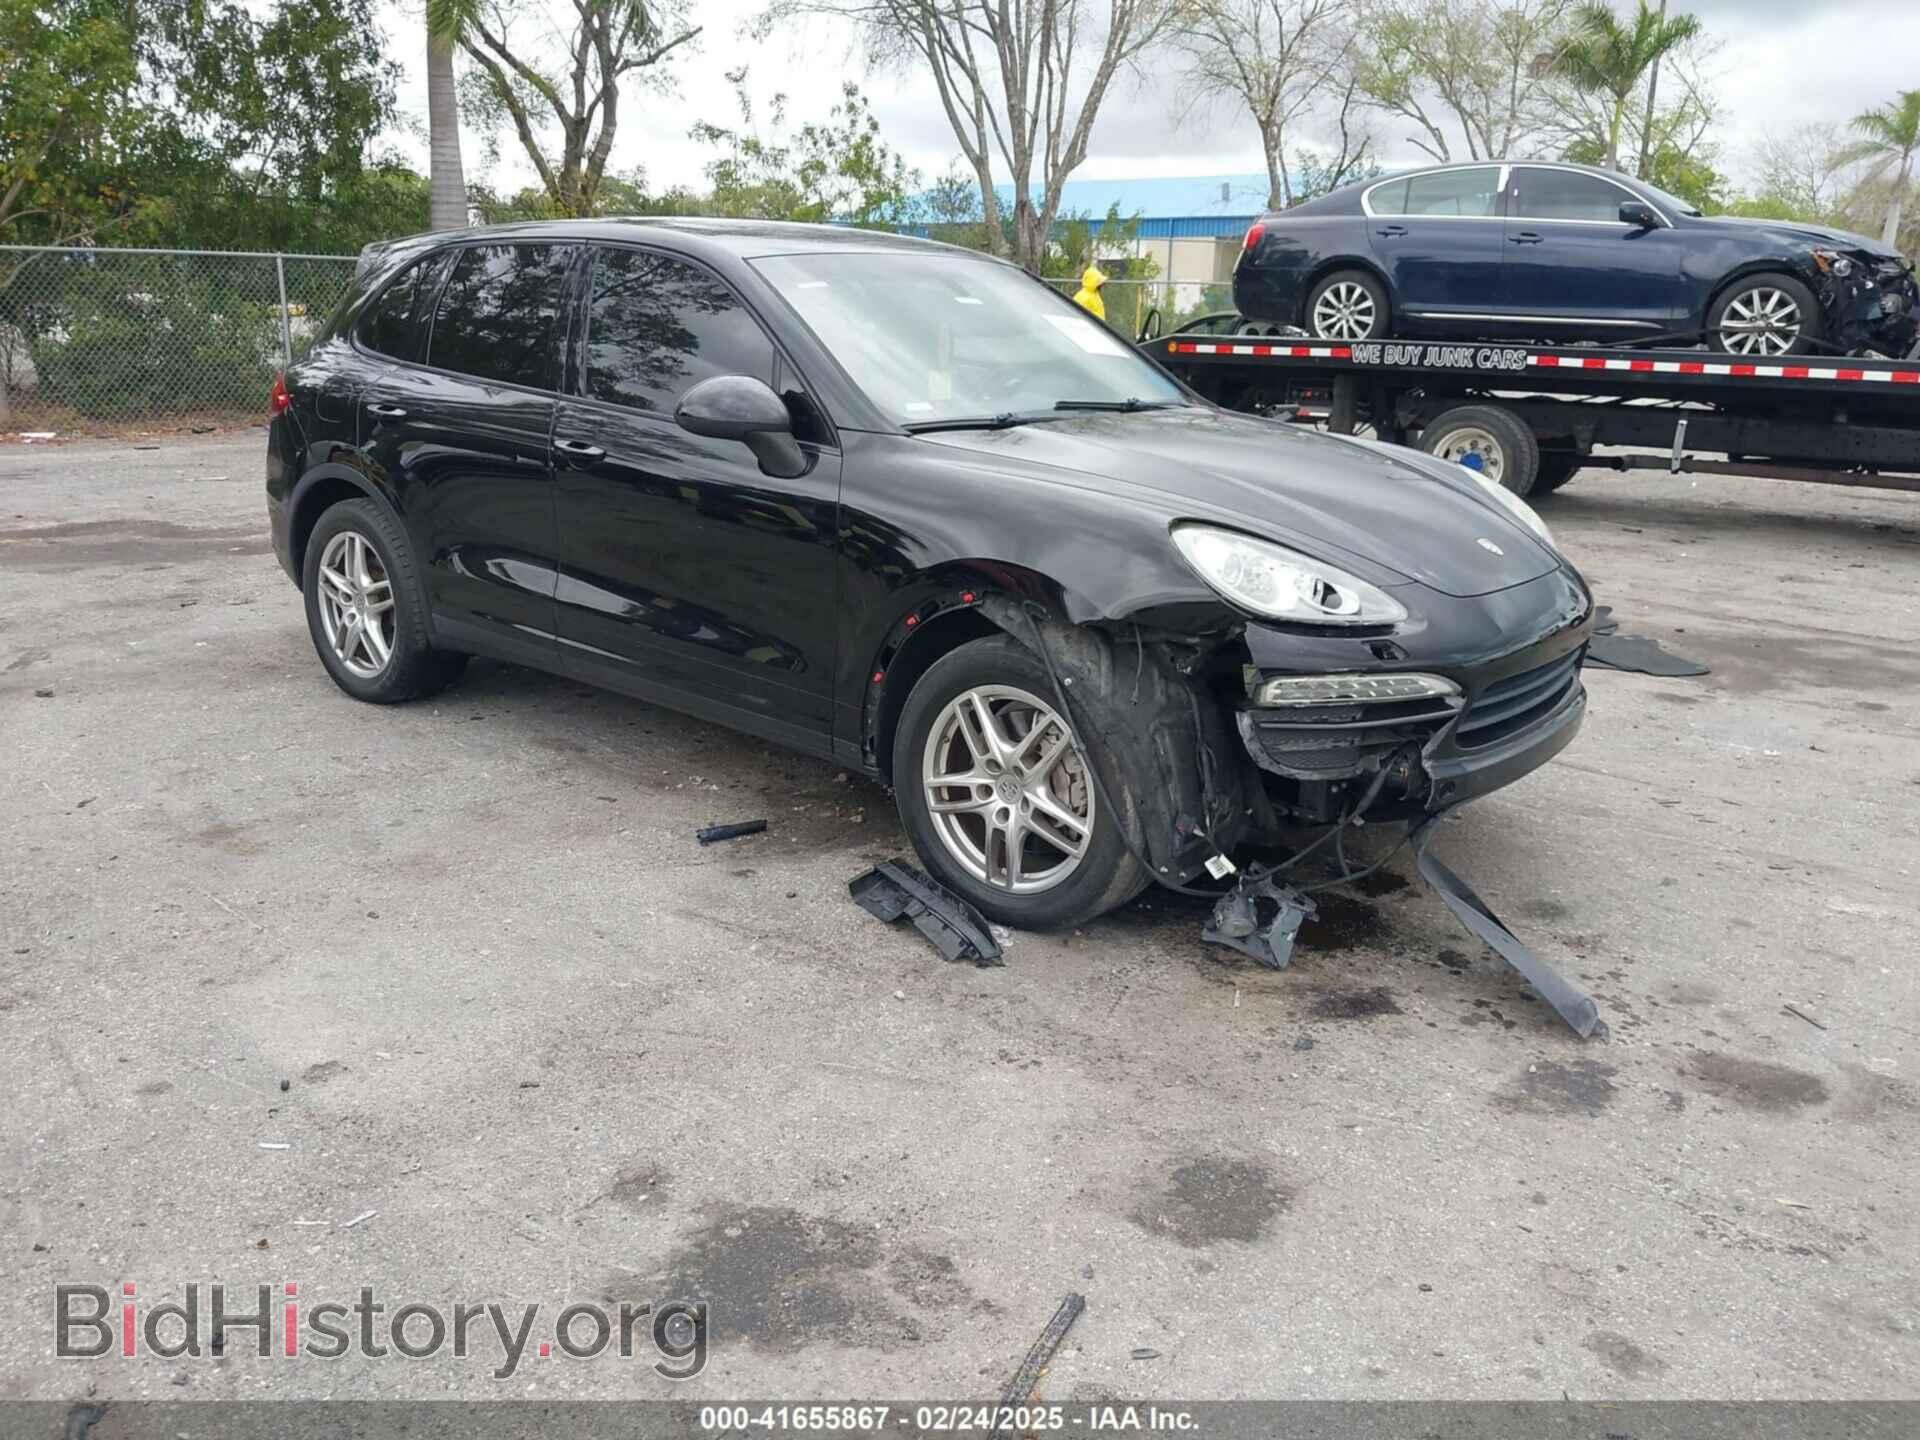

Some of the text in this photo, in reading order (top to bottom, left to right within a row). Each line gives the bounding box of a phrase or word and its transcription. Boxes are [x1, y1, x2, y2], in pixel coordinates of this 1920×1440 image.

[1351, 344, 1527, 370] WE BUY JUNK CARS
